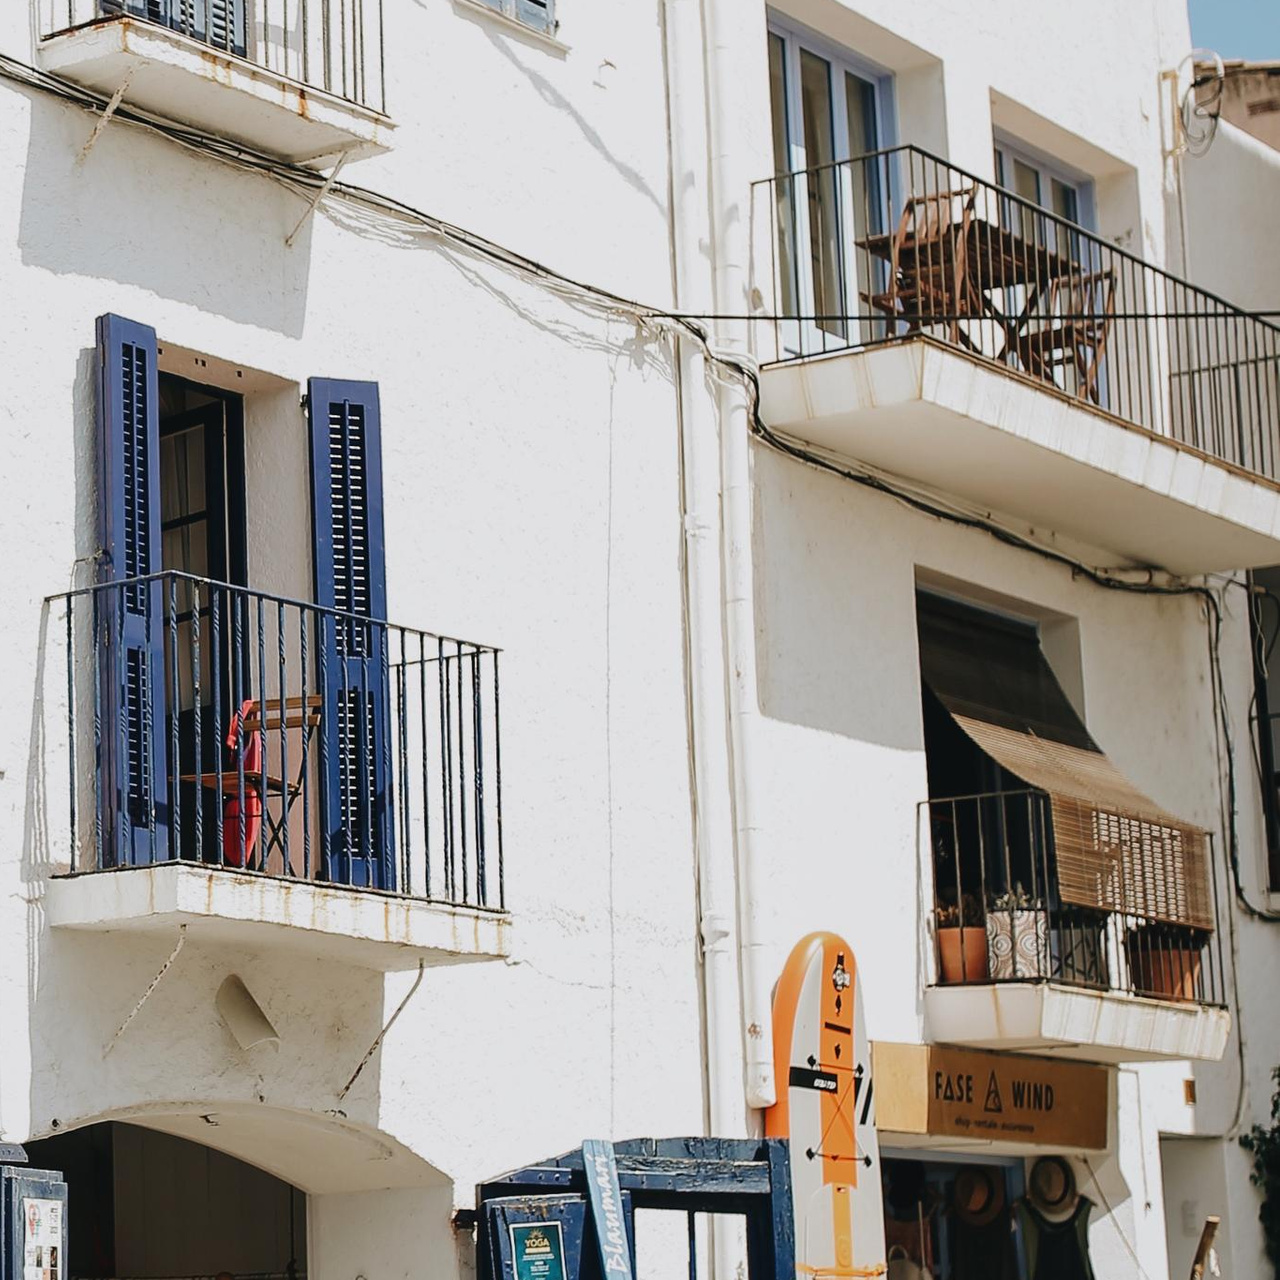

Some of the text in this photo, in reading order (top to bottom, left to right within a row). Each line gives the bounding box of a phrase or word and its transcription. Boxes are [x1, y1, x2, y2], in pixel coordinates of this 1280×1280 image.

[935, 1071, 1054, 1112] FASE WIND
[525, 1238, 550, 1248] YOGA
